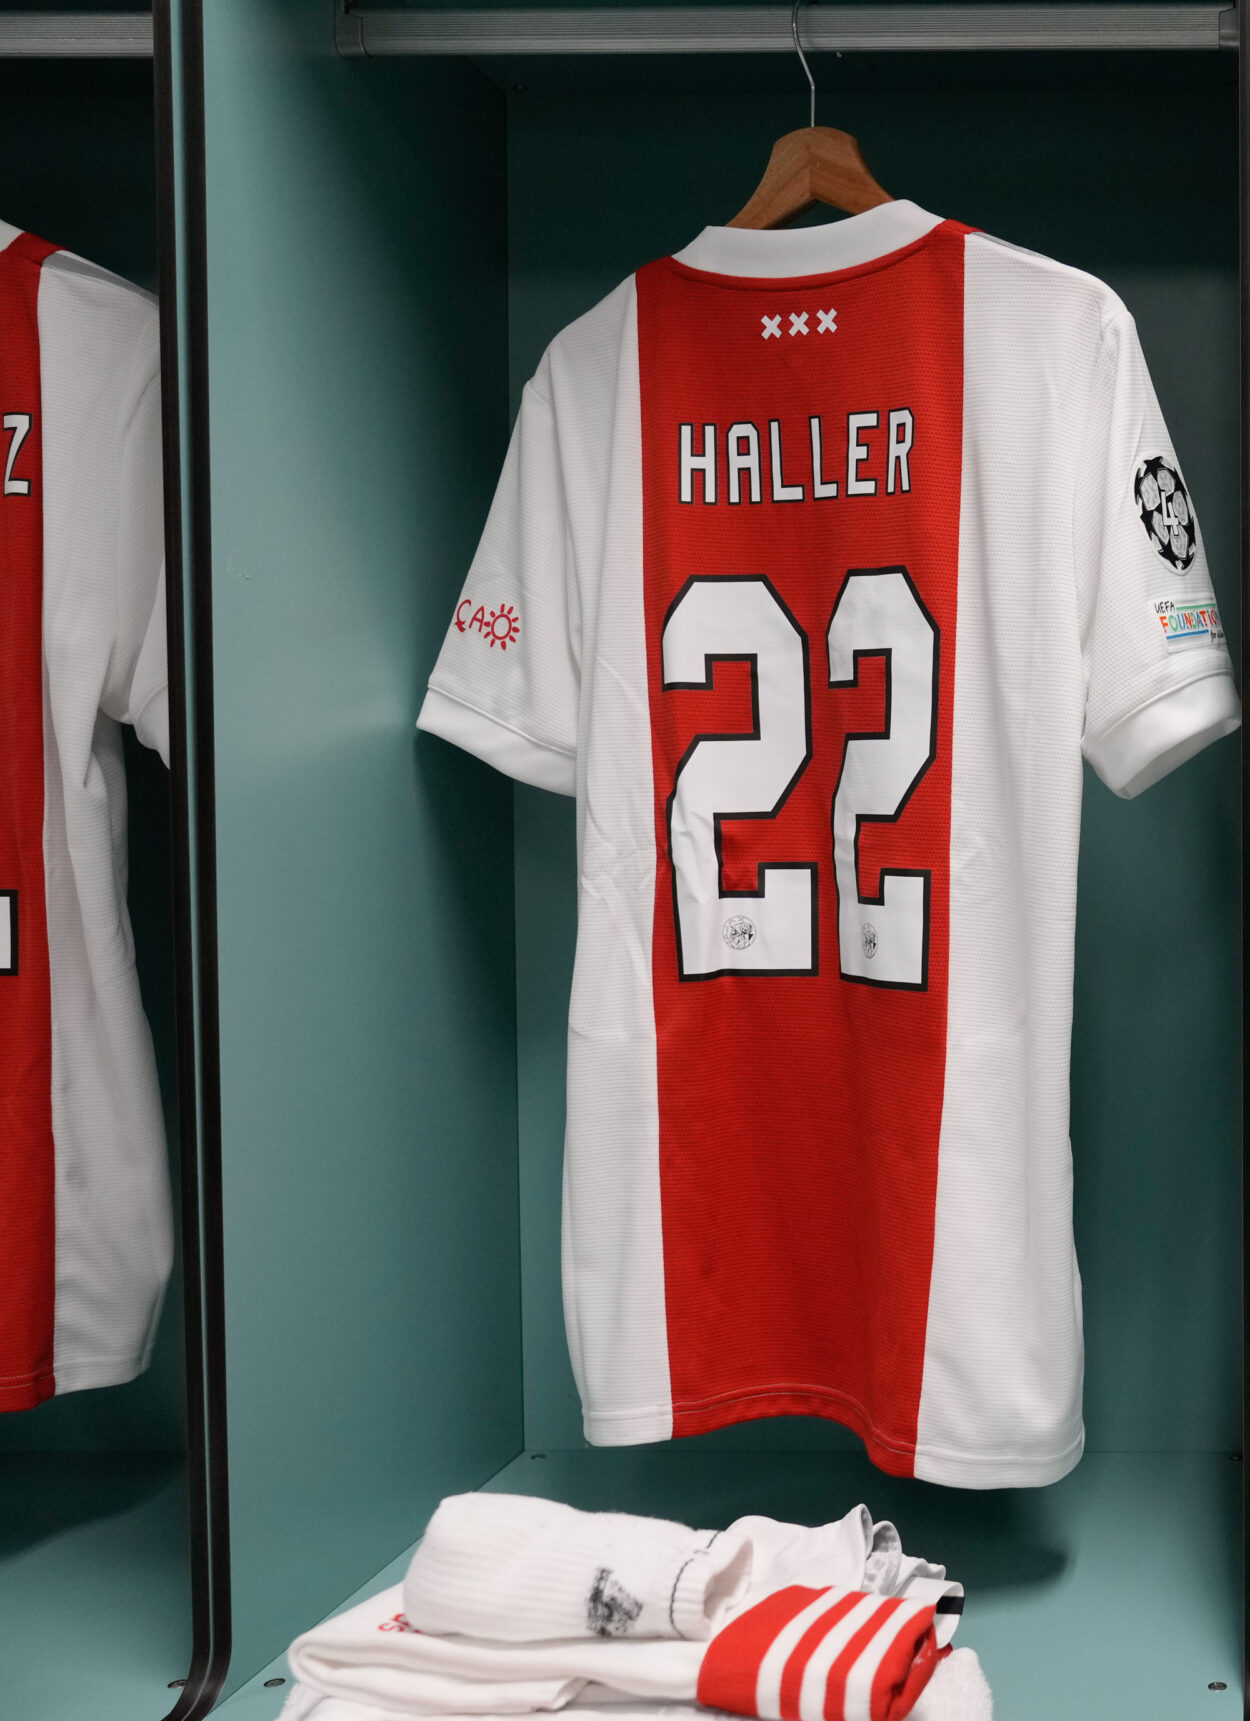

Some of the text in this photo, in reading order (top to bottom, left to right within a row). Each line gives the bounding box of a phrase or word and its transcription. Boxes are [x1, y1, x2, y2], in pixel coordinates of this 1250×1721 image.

[678, 407, 915, 505] HALLER
[1154, 601, 1175, 614] UEFA
[1160, 609, 1220, 634] FOUNDATIO
[661, 565, 941, 992] 22
